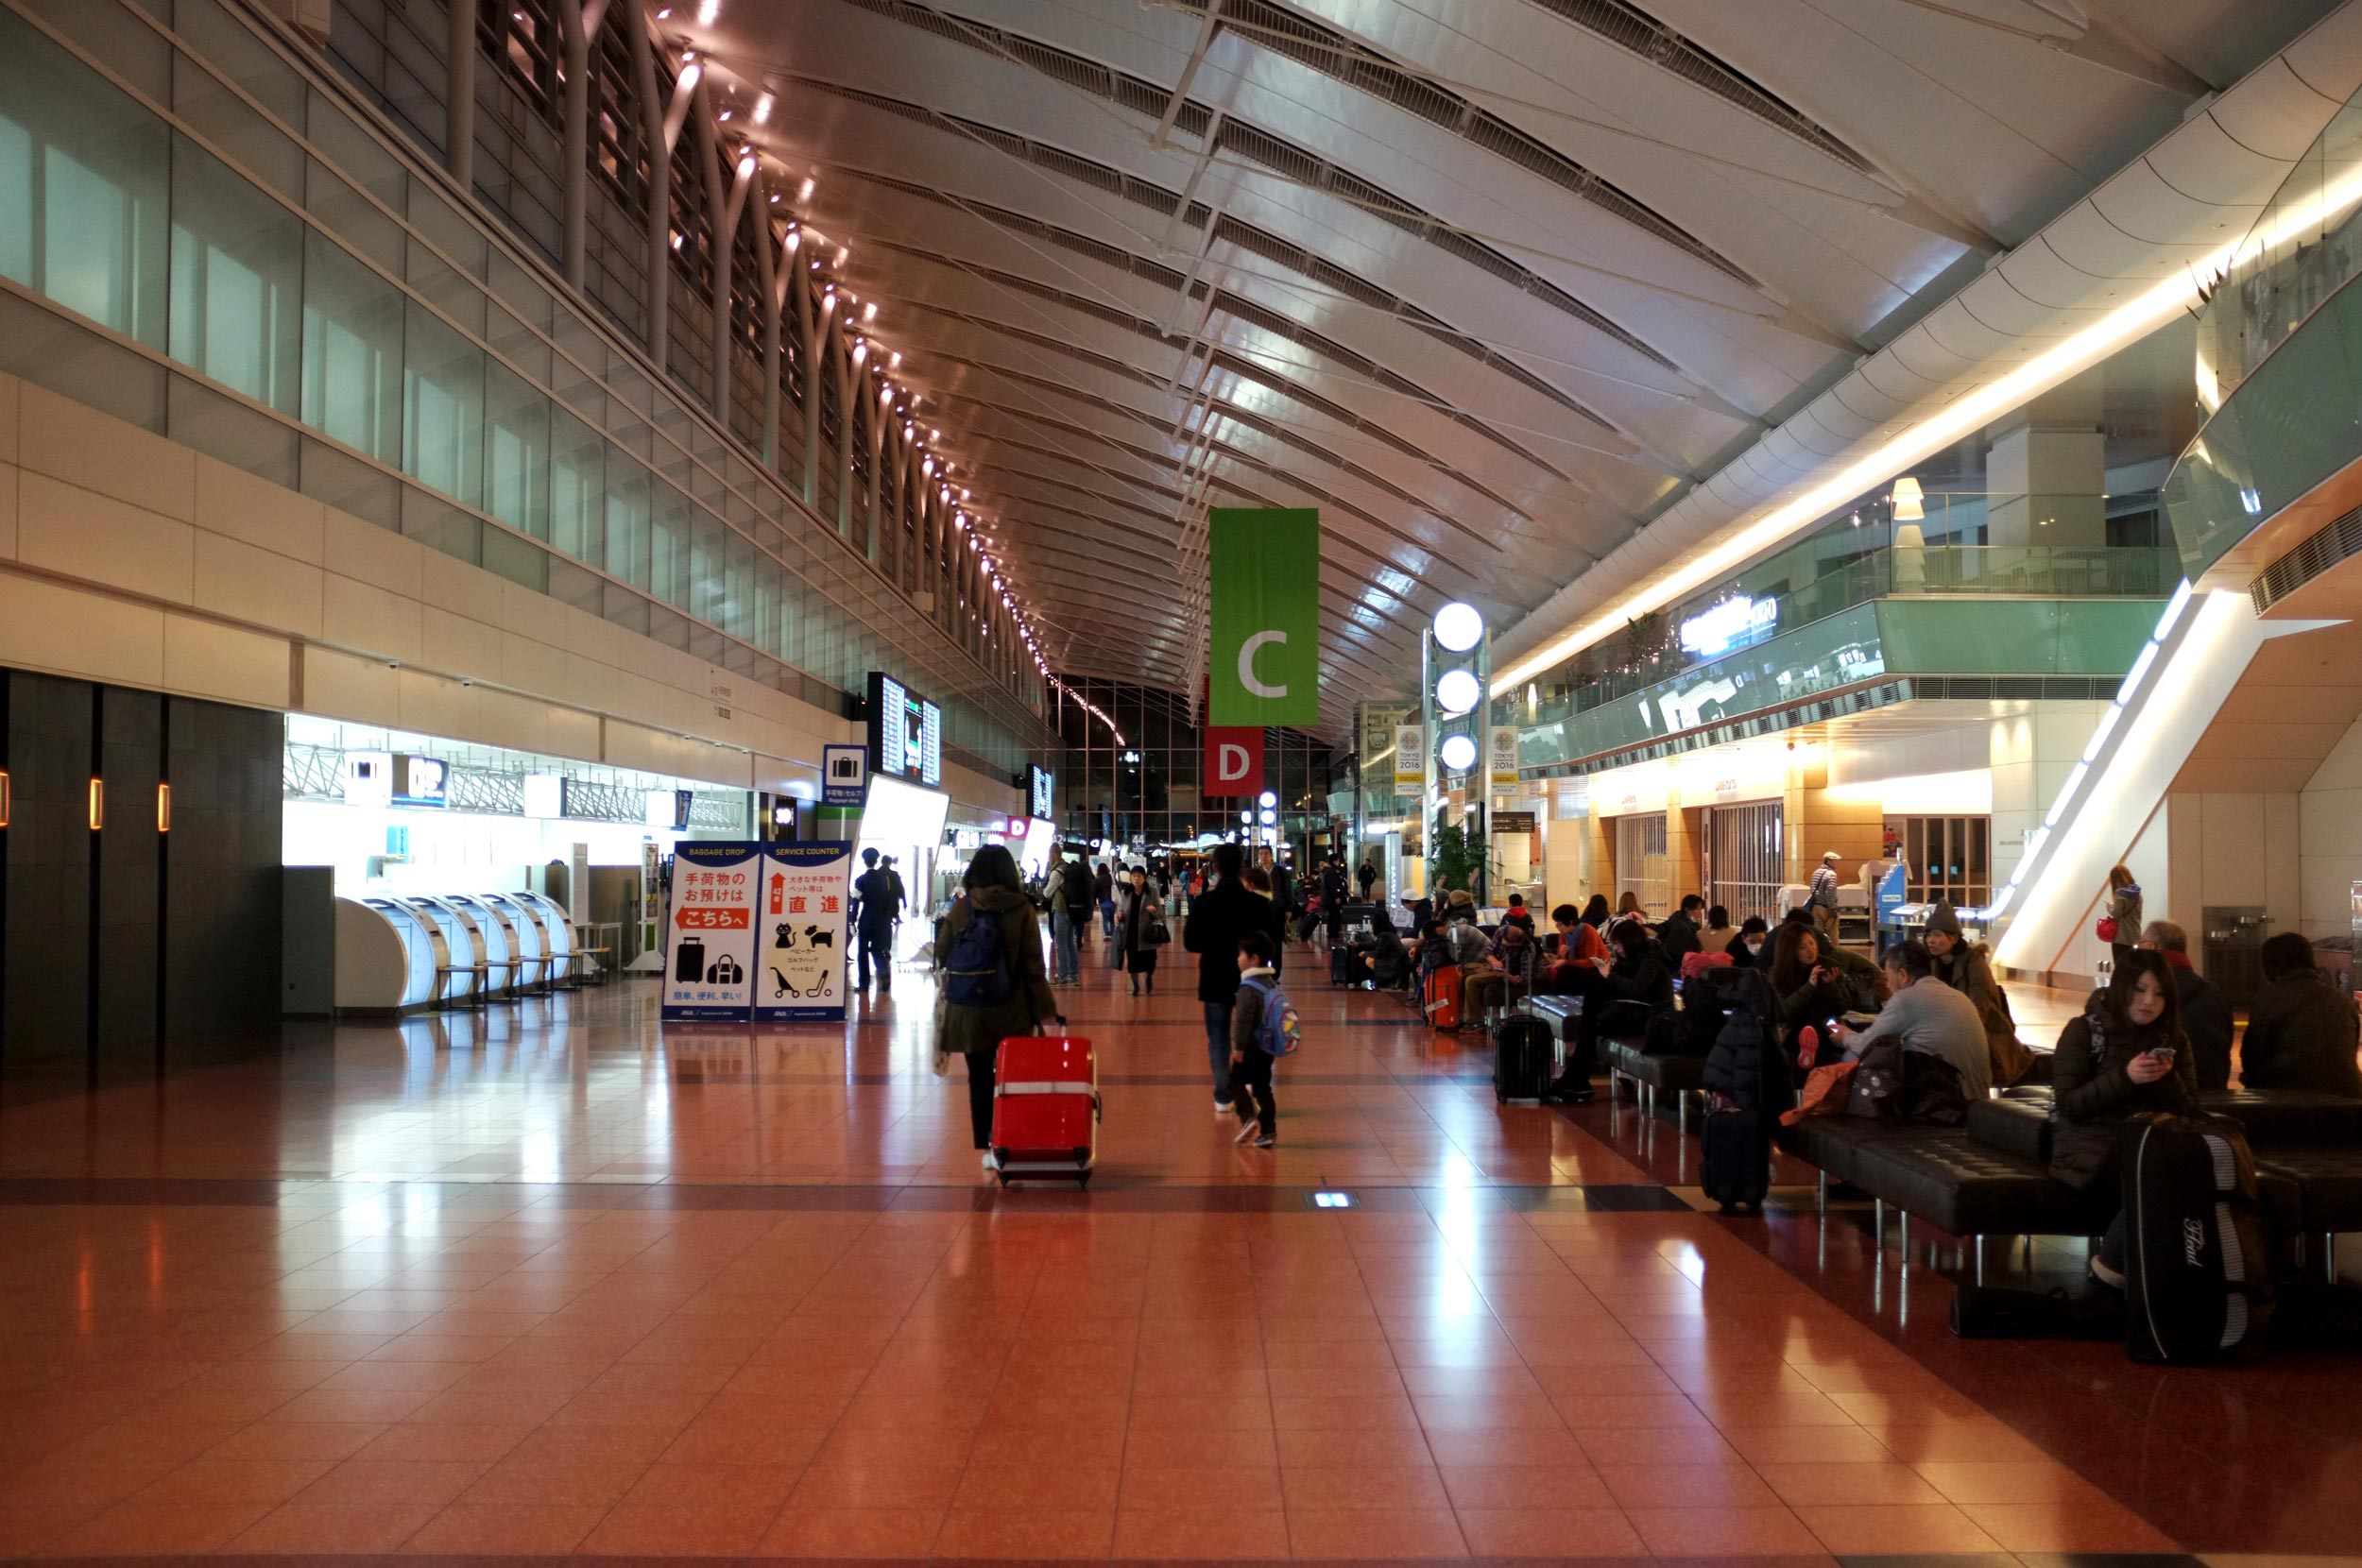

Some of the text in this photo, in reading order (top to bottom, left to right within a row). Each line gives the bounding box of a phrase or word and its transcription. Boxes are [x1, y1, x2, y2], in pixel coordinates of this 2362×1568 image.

[1238, 630, 1287, 698] C
[1219, 743, 1250, 781] D
[1012, 820, 1025, 836] D
[1133, 835, 1145, 844] 44
[685, 872, 745, 886] 手荷物の
[789, 876, 842, 884] 大きな手荷物や
[685, 889, 744, 903] お預けは
[789, 895, 839, 913] 直進
[686, 912, 743, 927] こちらへ
